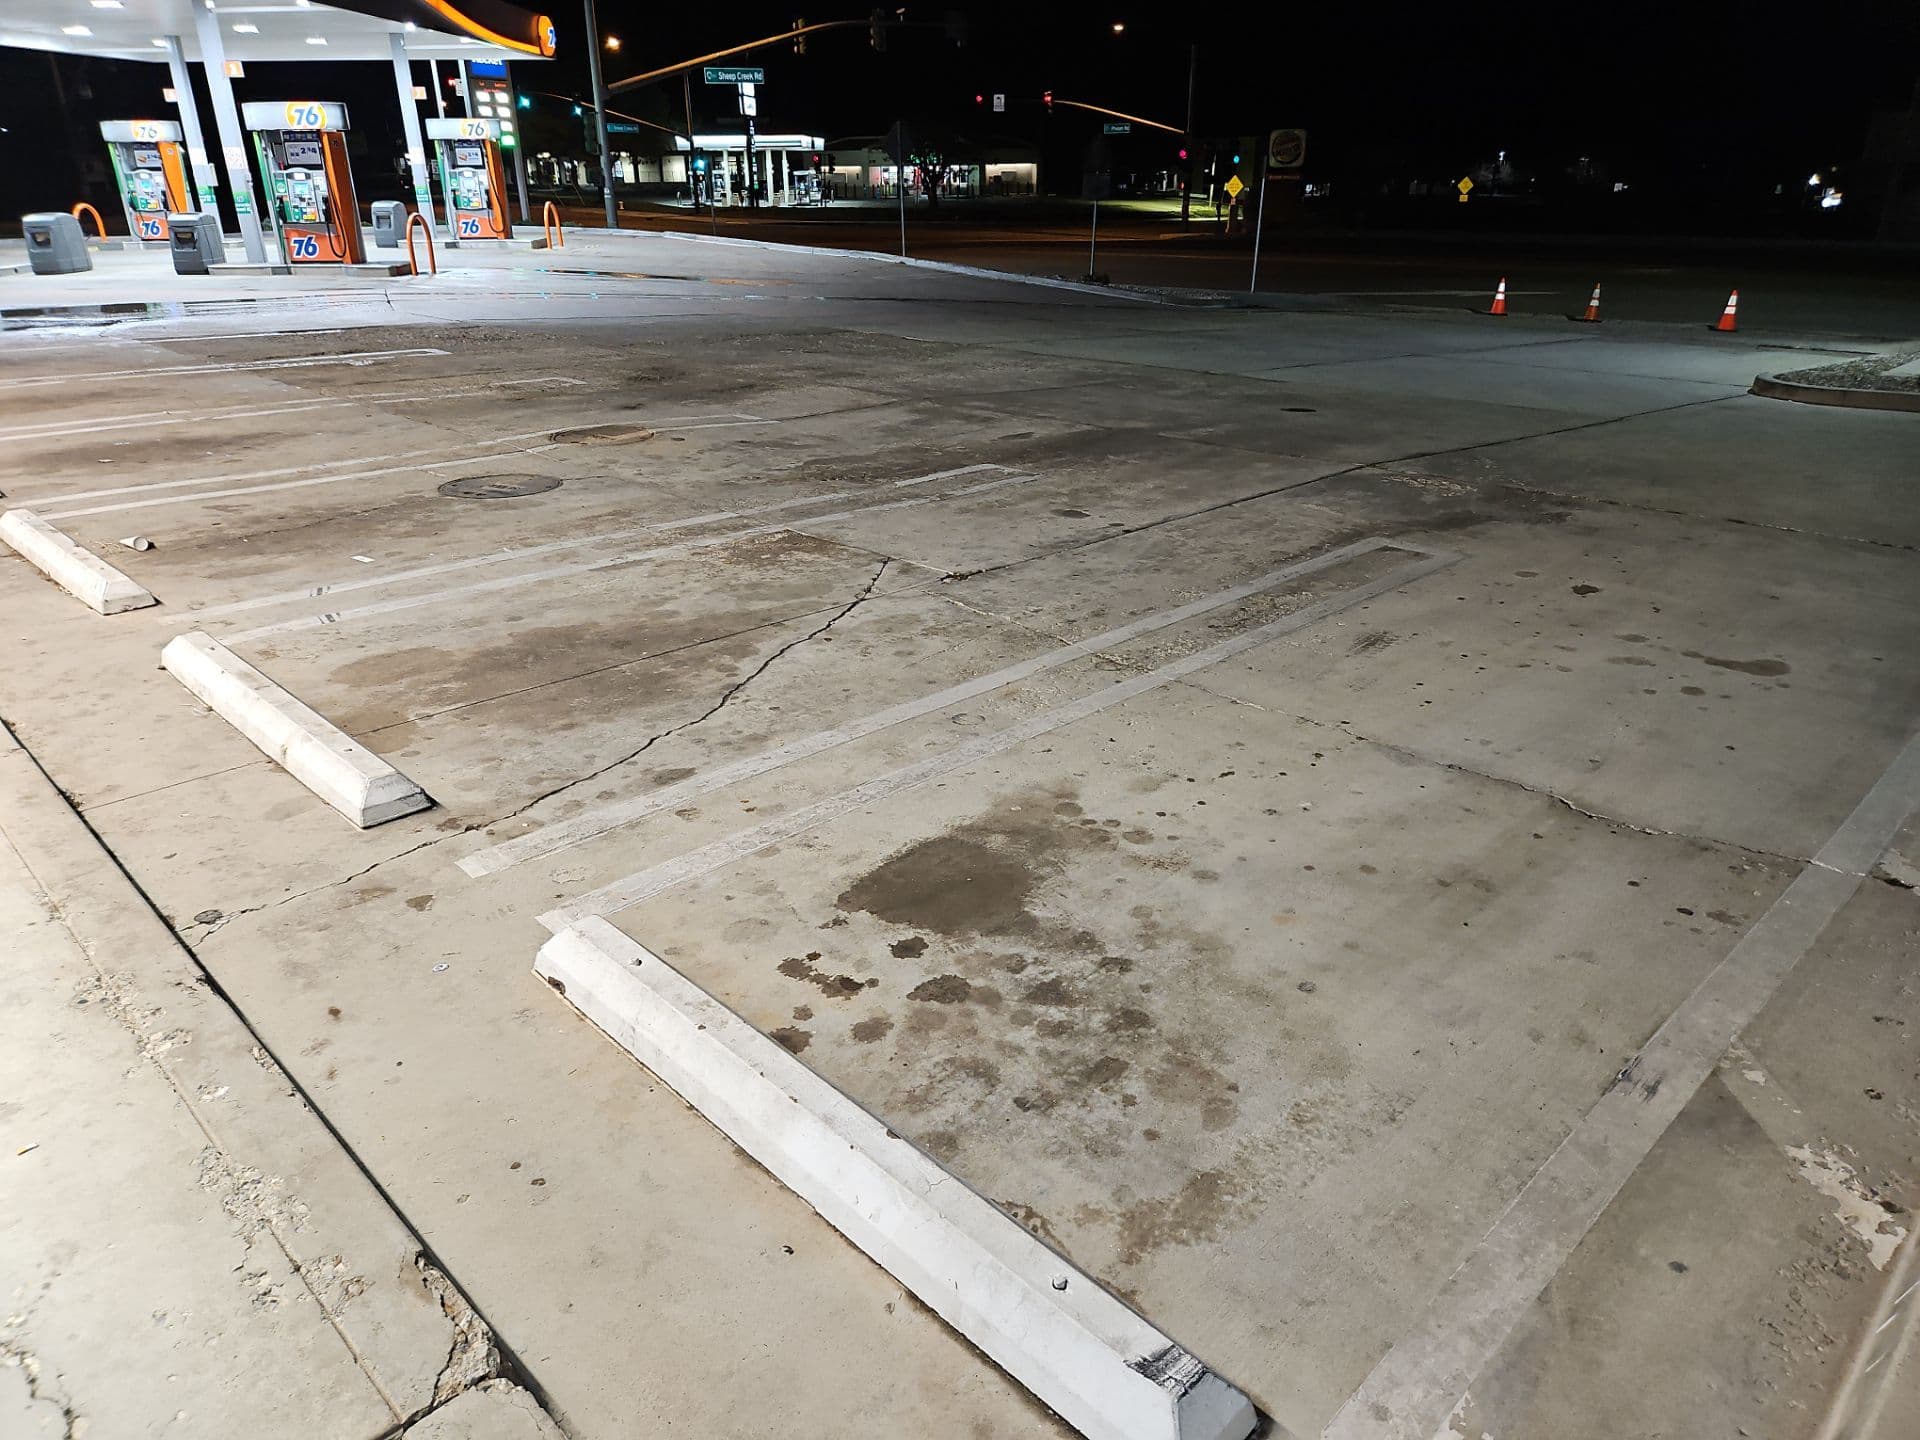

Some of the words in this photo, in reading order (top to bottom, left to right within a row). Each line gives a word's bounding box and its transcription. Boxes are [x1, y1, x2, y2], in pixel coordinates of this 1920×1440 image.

[718, 71, 737, 82] Sheep
[737, 71, 753, 81] Creek
[754, 71, 763, 81] Rd
[294, 101, 319, 126] 76
[139, 126, 158, 139] 76
[467, 122, 485, 137] 76
[141, 220, 160, 237] 76
[461, 219, 480, 235] 76
[292, 236, 319, 257] 76
